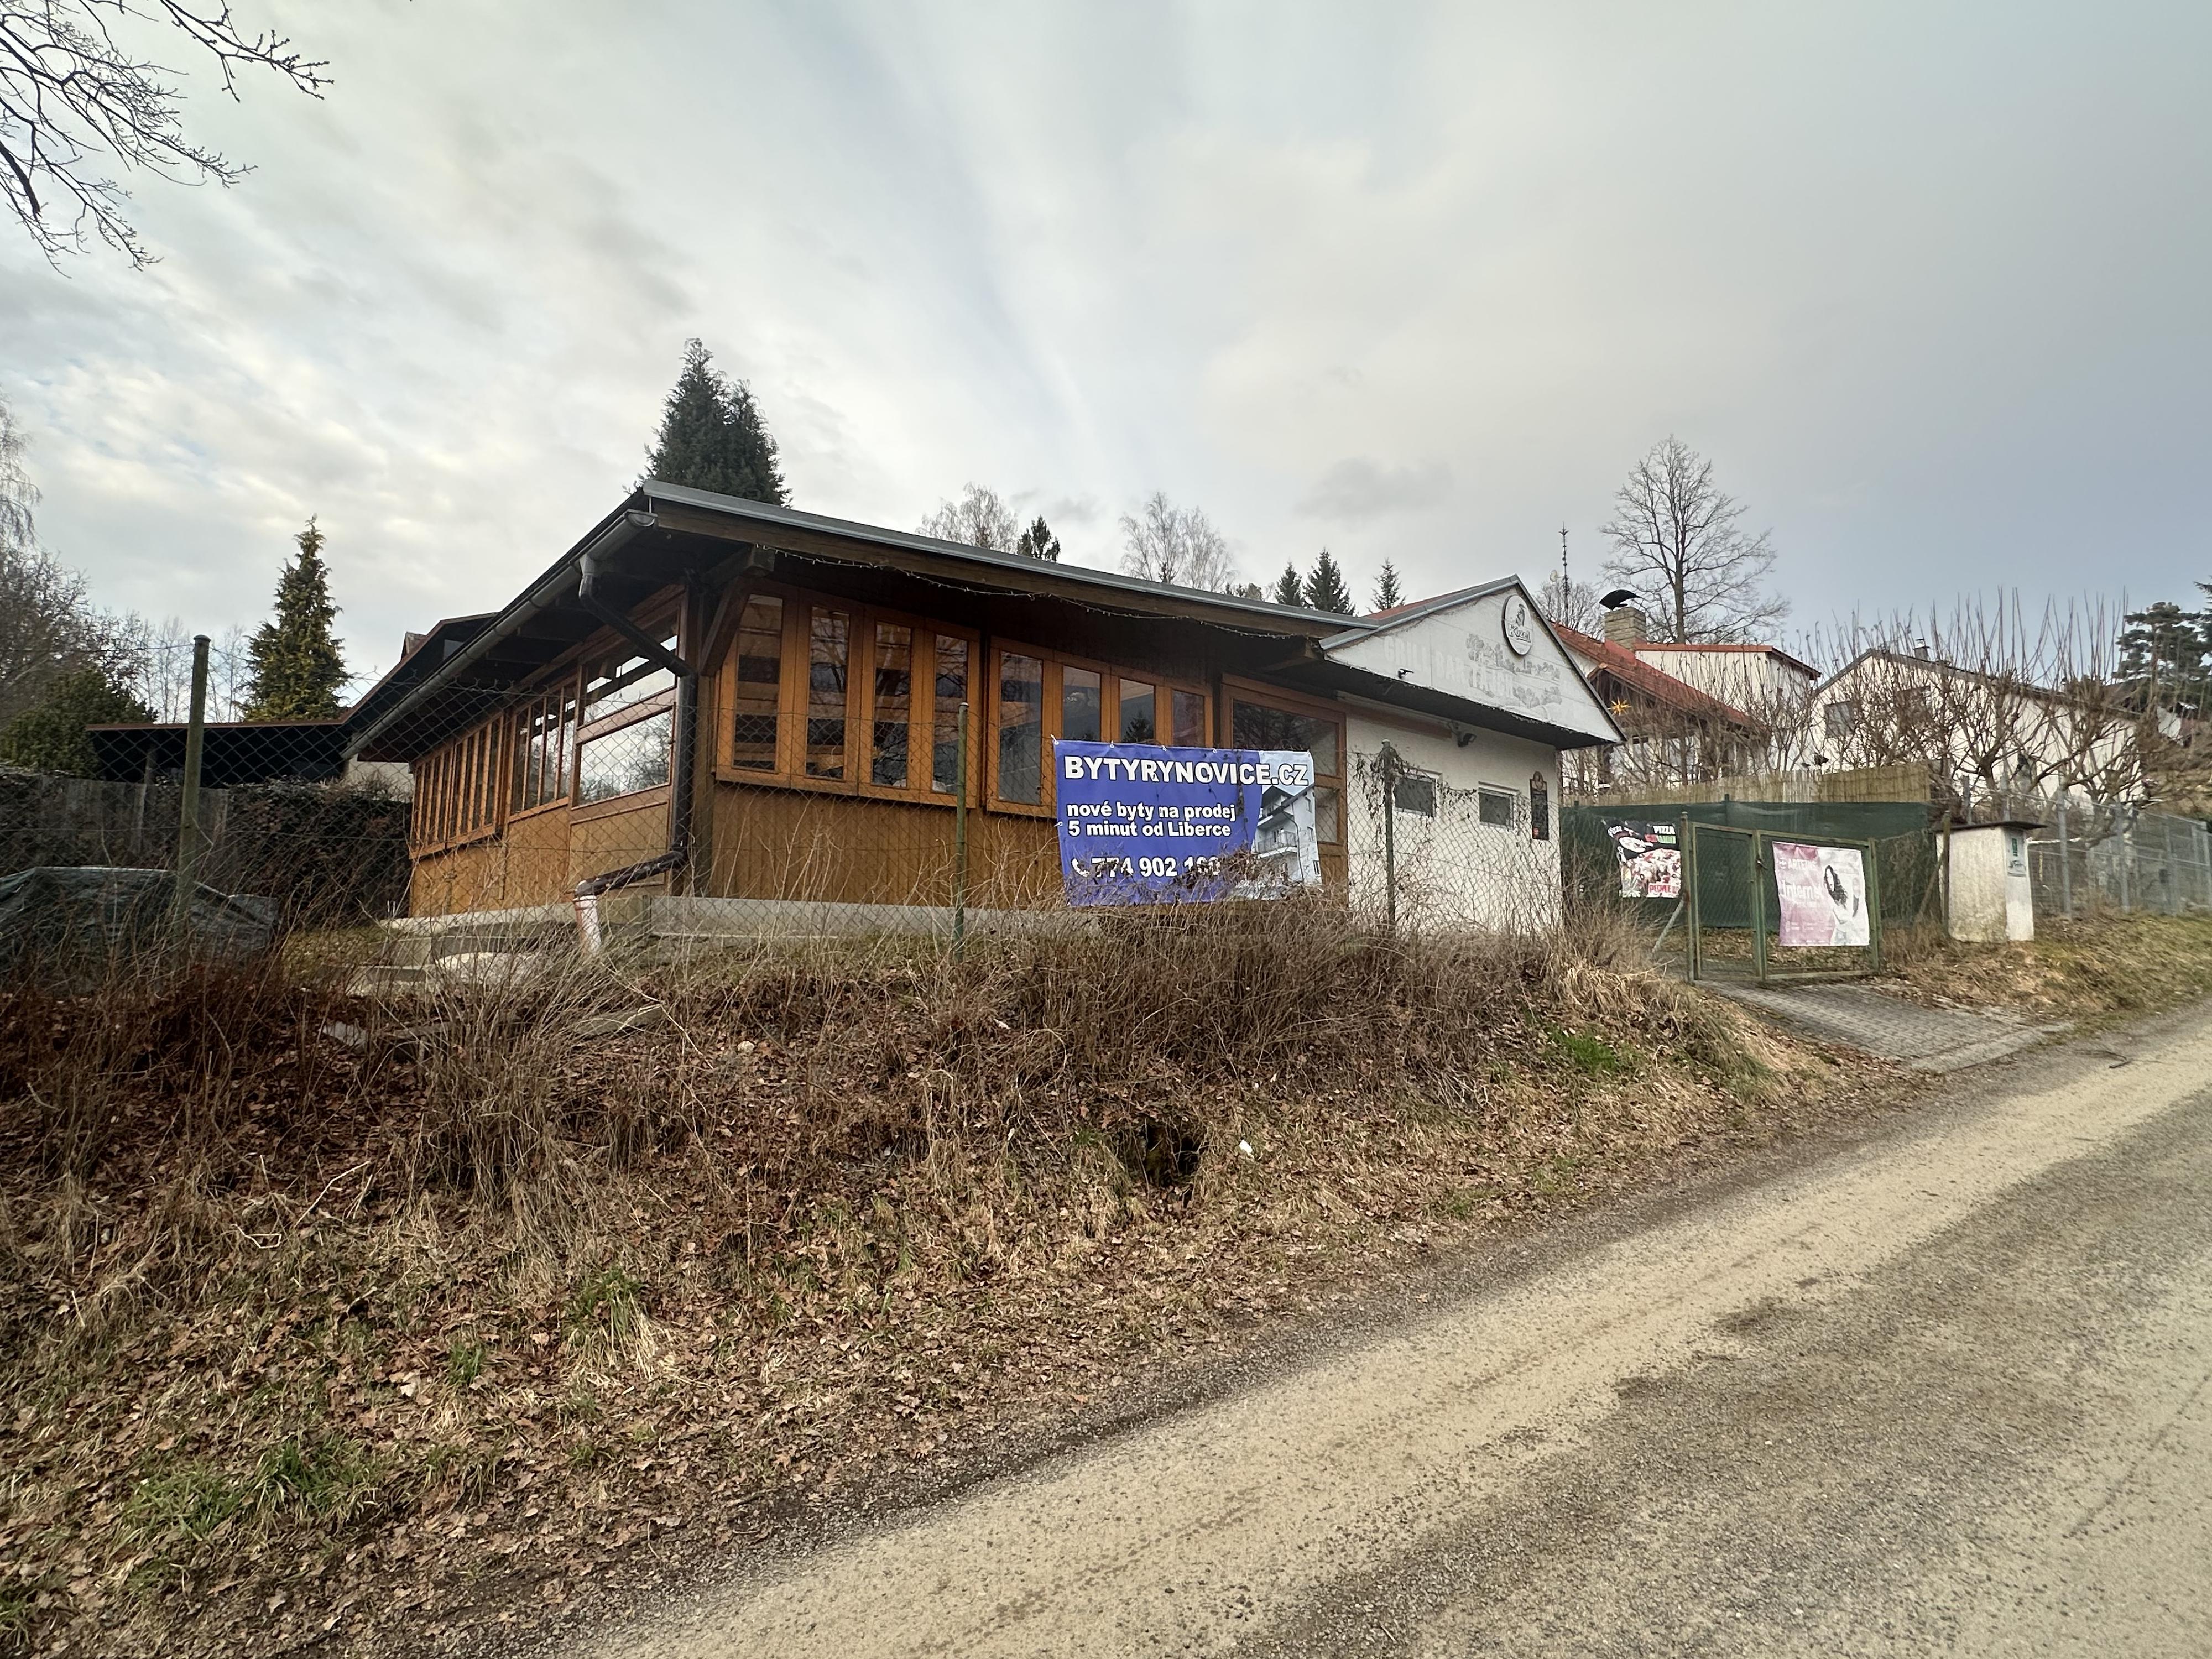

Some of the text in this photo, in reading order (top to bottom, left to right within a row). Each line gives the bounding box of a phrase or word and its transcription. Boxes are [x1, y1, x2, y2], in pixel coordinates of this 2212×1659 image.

[1064, 755, 1310, 785] BYTYRYNOVICE.CZ
[1067, 801, 1235, 822] nové byty na prodej
[1068, 820, 1232, 837] 5 minut od Liberce
[1653, 825, 1676, 834] PIZZA
[1091, 857, 1134, 877] 774
[1139, 857, 1177, 877] 902
